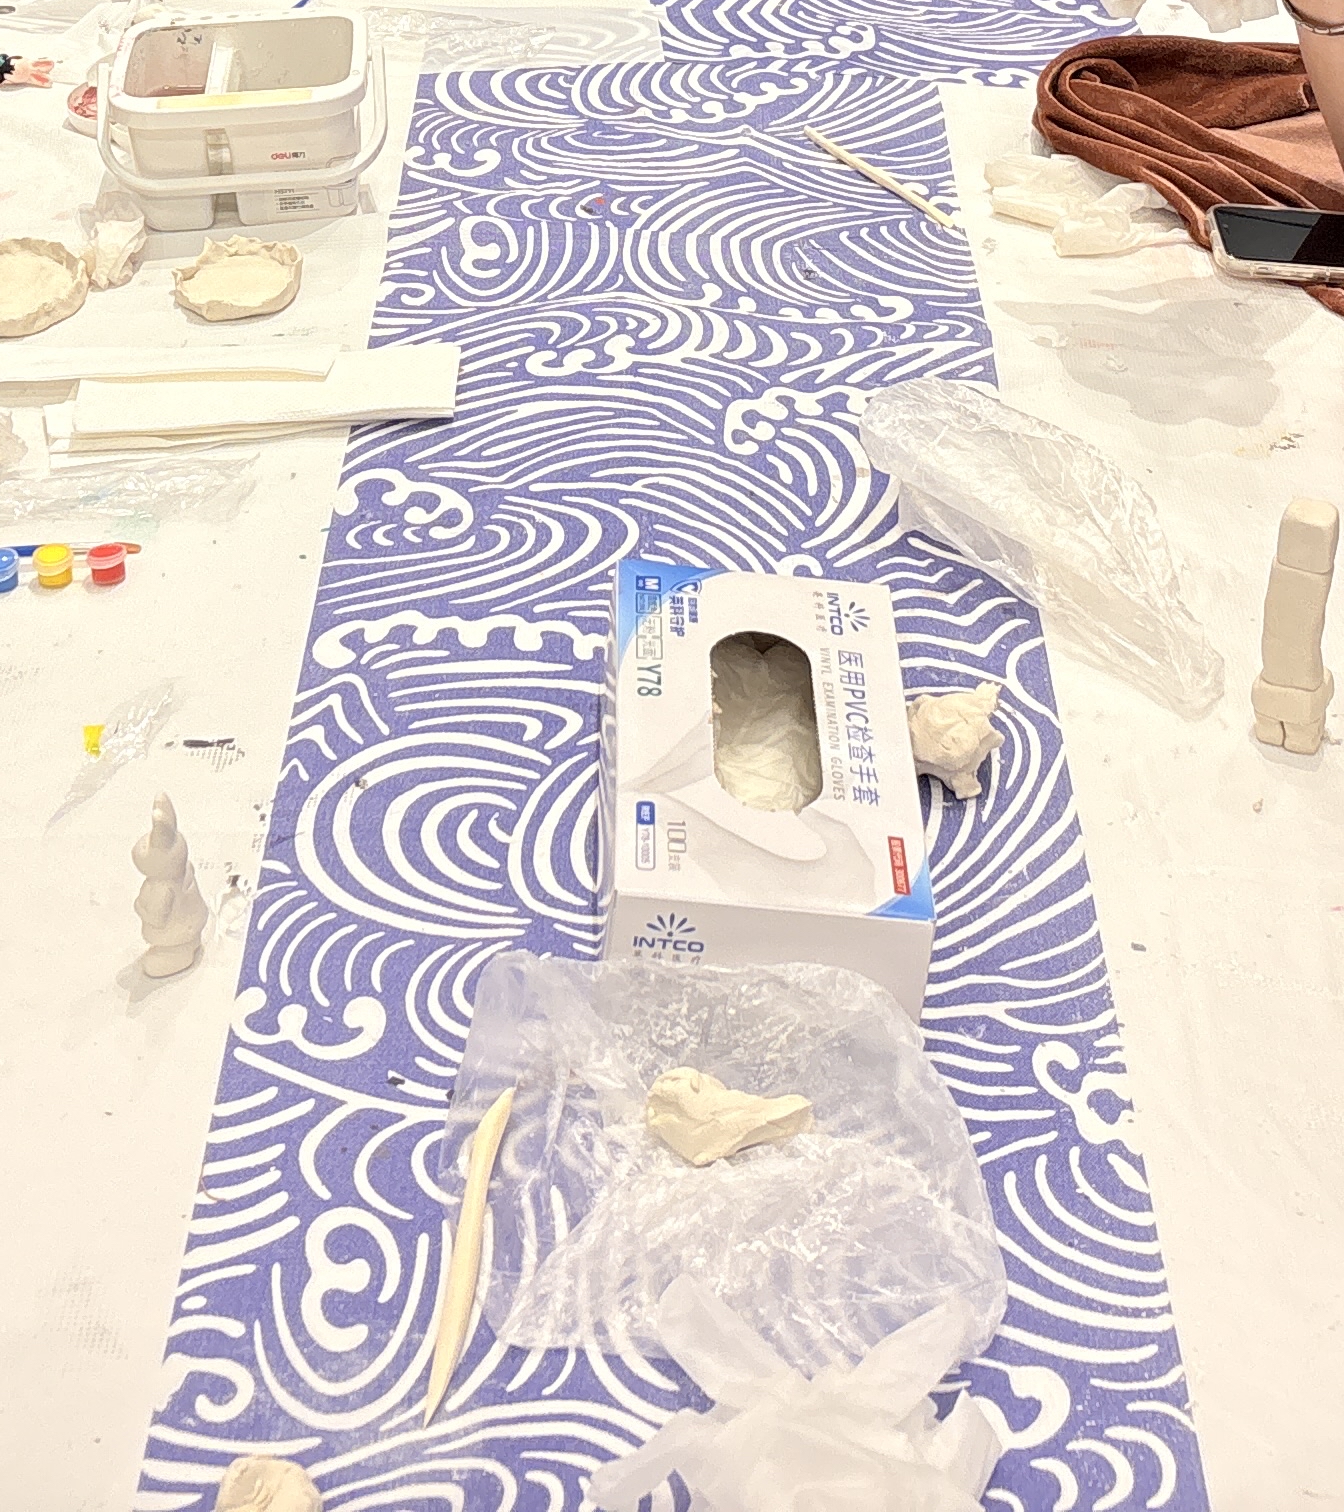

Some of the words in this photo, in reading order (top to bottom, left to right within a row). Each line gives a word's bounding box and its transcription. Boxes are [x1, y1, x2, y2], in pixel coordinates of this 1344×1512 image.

[826, 591, 844, 636] INTCO
[637, 664, 662, 696] Y78
[819, 647, 832, 675] VINYL
[822, 681, 841, 751] EXAMINATION
[838, 649, 880, 807] 医用PVC检查手套
[830, 756, 846, 802] GLOVES
[632, 935, 705, 953] INTCO
